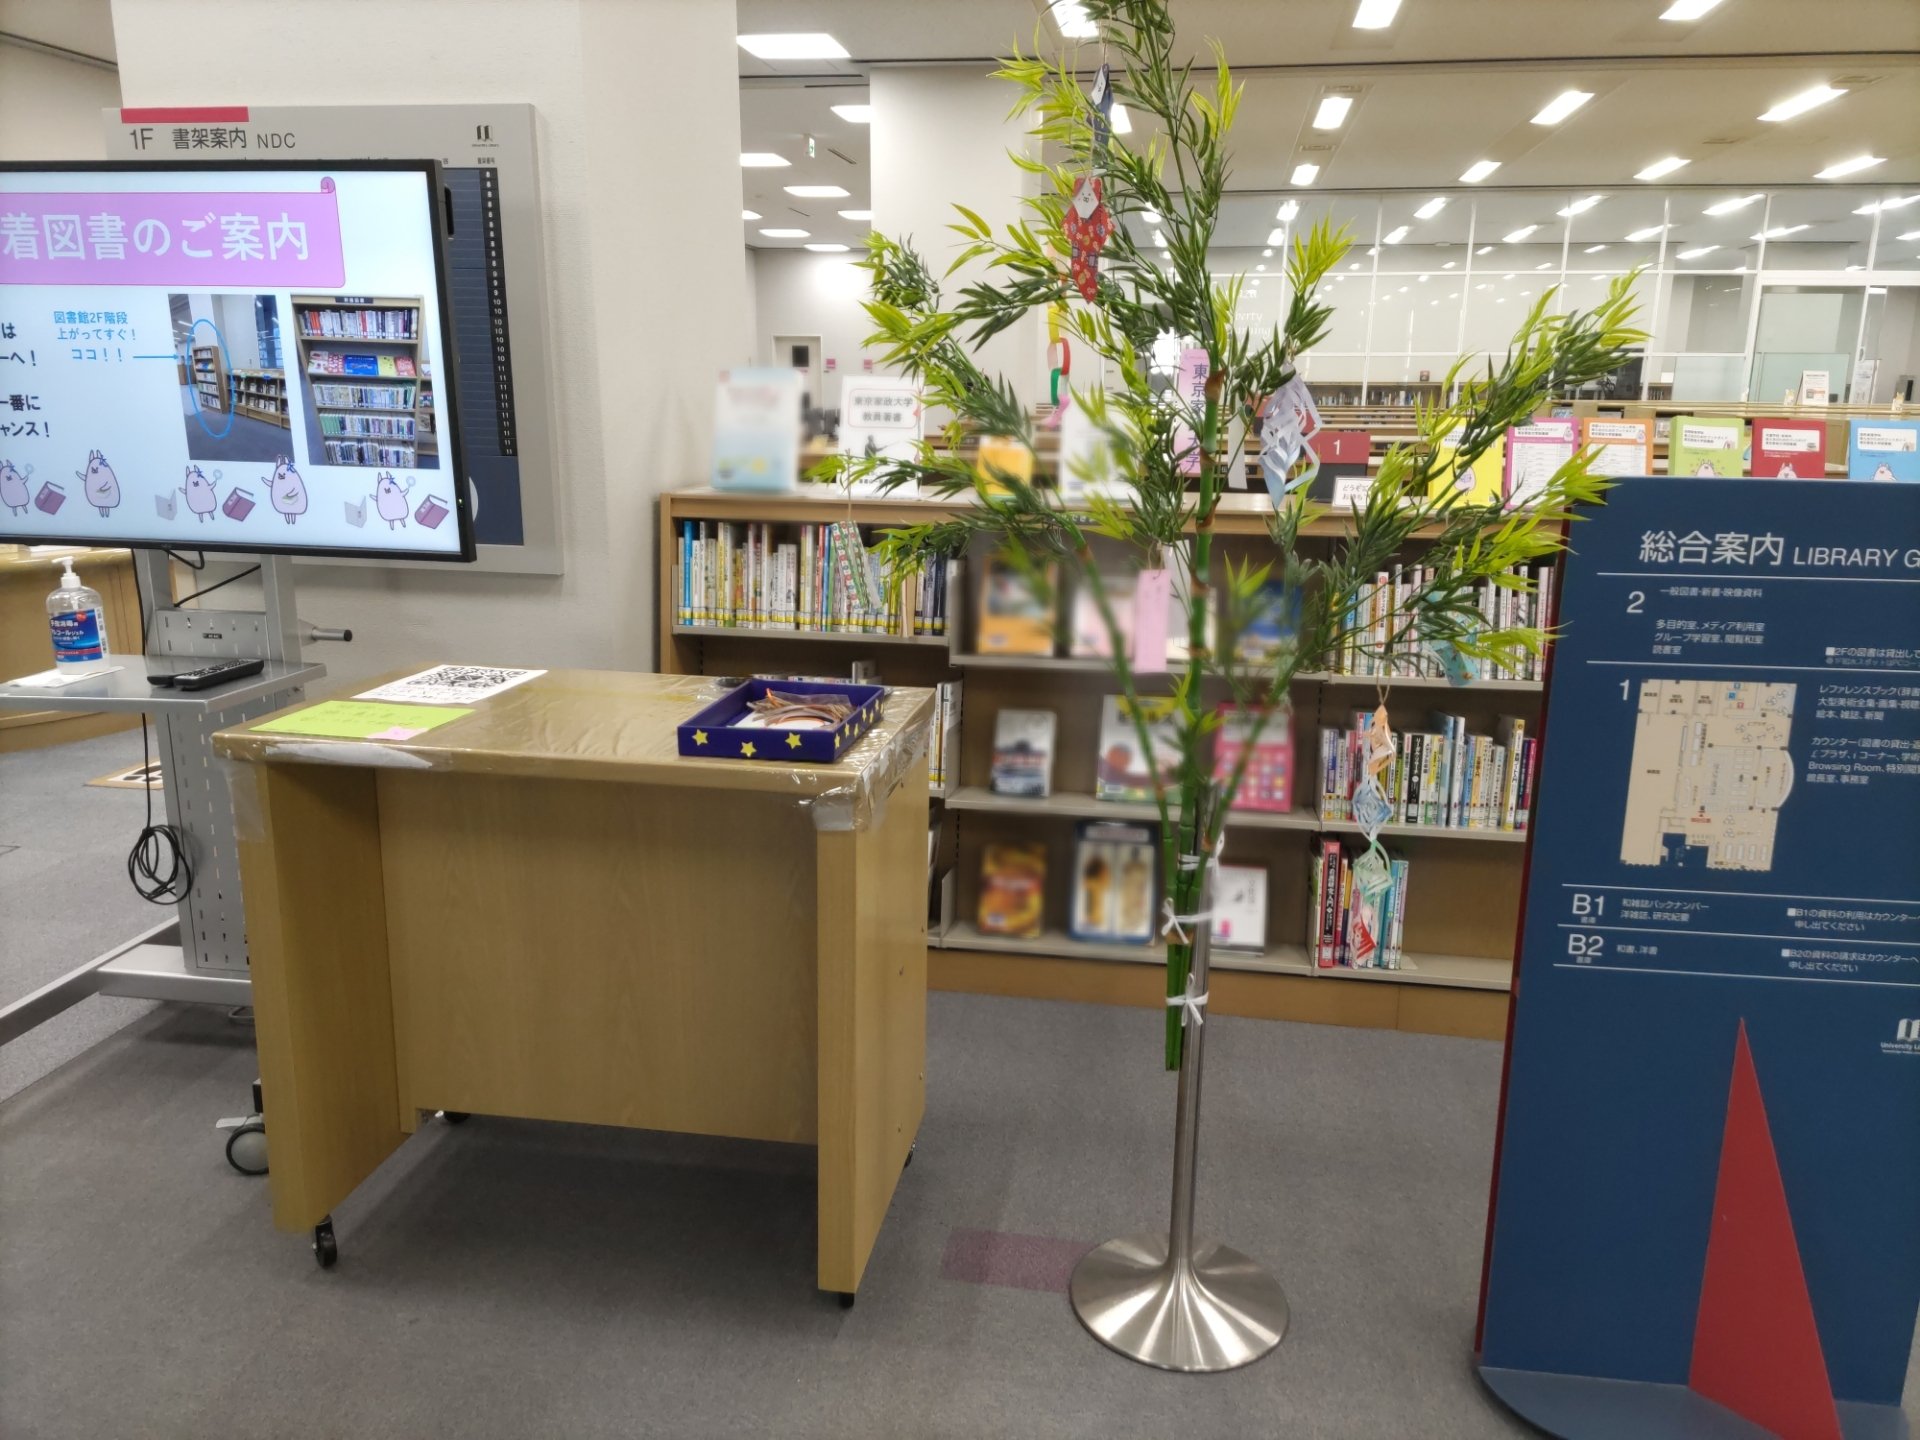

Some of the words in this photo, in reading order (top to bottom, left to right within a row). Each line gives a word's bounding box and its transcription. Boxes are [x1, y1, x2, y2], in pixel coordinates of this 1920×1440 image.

[130, 128, 154, 150] 1F
[172, 128, 247, 149] 書架案内
[257, 133, 296, 149] NDC
[0, 212, 309, 261] 着図書のご案内
[54, 311, 128, 325] 図書館2F階段
[57, 327, 136, 342] 上がってすぐ！
[71, 347, 123, 362] ココ！！
[1185, 363, 1209, 468] 東京家大学
[1333, 439, 1341, 456] 1
[1639, 530, 1785, 566] 総合案内
[1793, 547, 1899, 568] LIBRARY
[1626, 591, 1645, 614] 2
[1619, 680, 1630, 700] 1
[1808, 761, 1851, 772] Browsing
[1572, 893, 1604, 916] B1
[1795, 920, 1865, 931] 申し出てください
[1568, 933, 1604, 956] B2
[1788, 961, 1859, 972] 申し出てください
